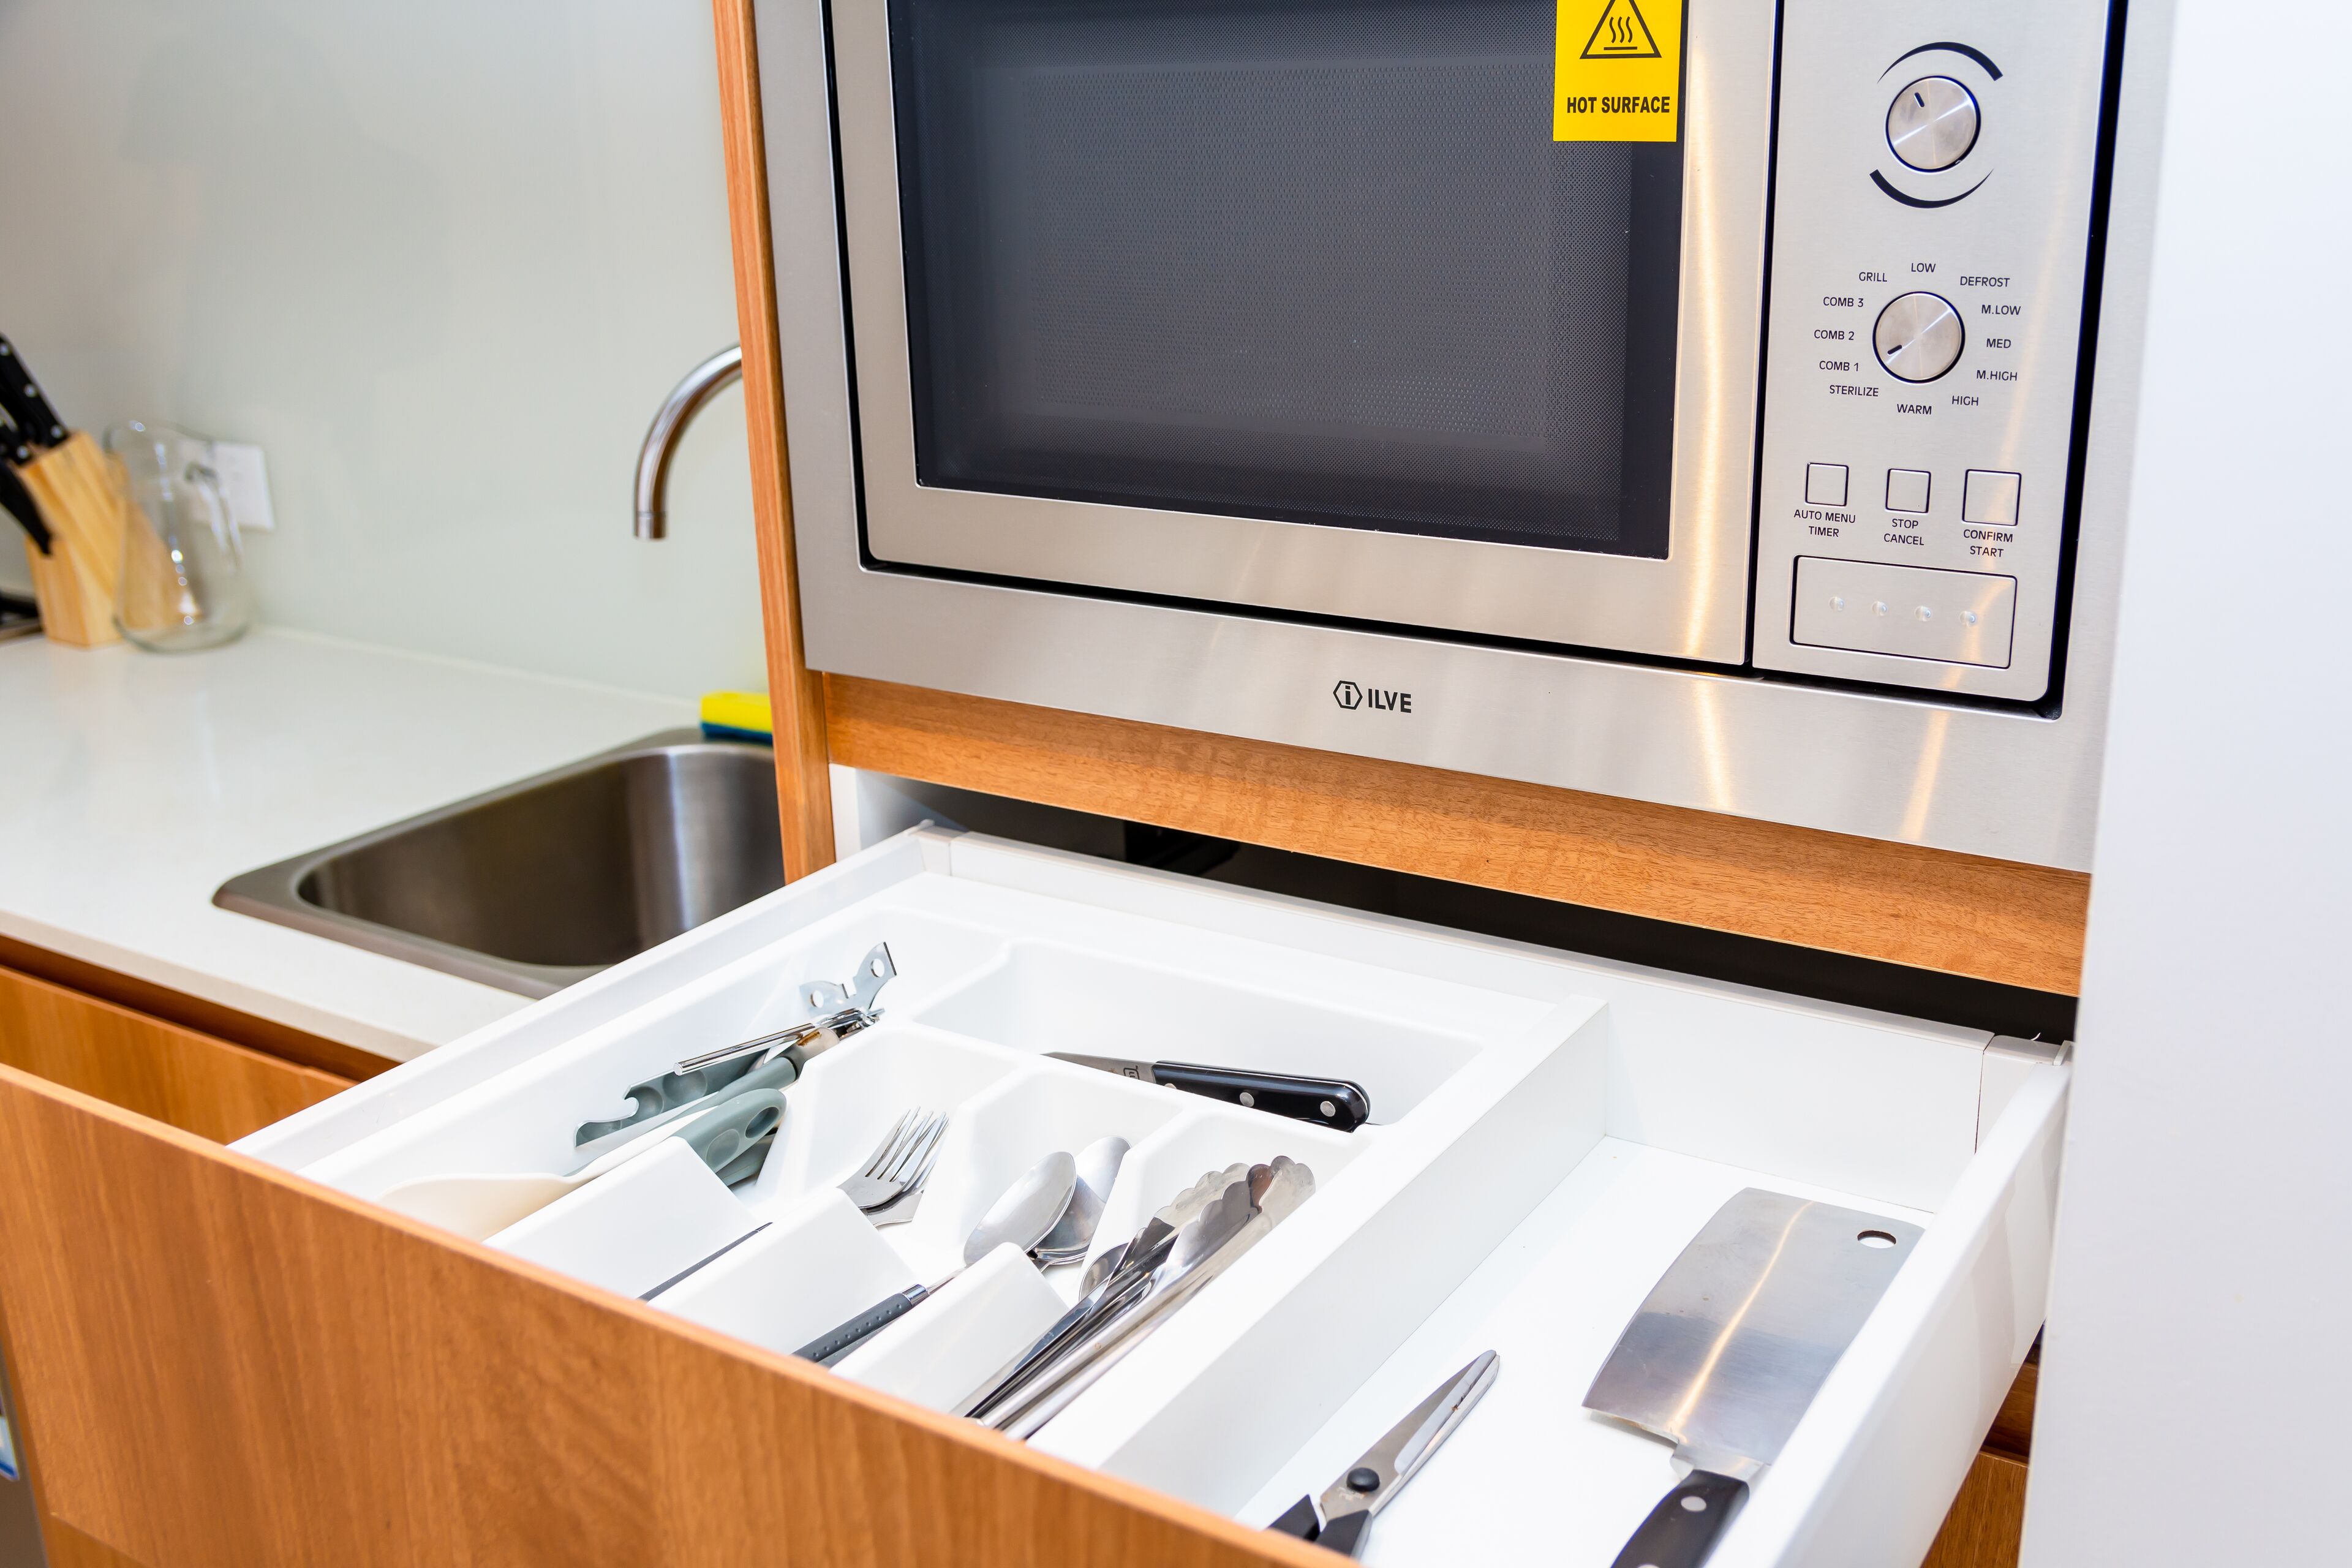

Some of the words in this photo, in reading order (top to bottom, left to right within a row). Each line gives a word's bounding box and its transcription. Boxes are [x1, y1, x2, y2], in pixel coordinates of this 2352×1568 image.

[1567, 97, 1597, 113] HOT
[1602, 96, 1670, 113] SURFACE
[1912, 263, 1936, 273] LOW
[1859, 272, 1887, 282] GRILL
[1961, 276, 2010, 287] DEFROST
[1823, 297, 1853, 306] COMB
[1858, 298, 1863, 307] 3
[1982, 304, 2021, 315] M.LOW
[1814, 330, 1844, 339] COMB
[1849, 331, 1854, 340] 2
[1987, 339, 2011, 348] MED
[1820, 361, 1849, 371] COMB
[1854, 363, 1858, 371] 1
[1977, 370, 2017, 380] M.HIGH
[1830, 385, 1879, 396] STERILIZE
[1952, 396, 1978, 405] HIGH
[1897, 404, 1931, 415] WARM
[1794, 510, 1822, 520] AUTO
[1826, 513, 1855, 523] MENU
[1892, 519, 1918, 529] STOP
[1809, 526, 1839, 537] TIMER
[1964, 529, 2013, 542] CONFIRM
[1884, 533, 1924, 545] CANCEL
[1970, 546, 2003, 557] START
[1368, 688, 1411, 713] ILVE
